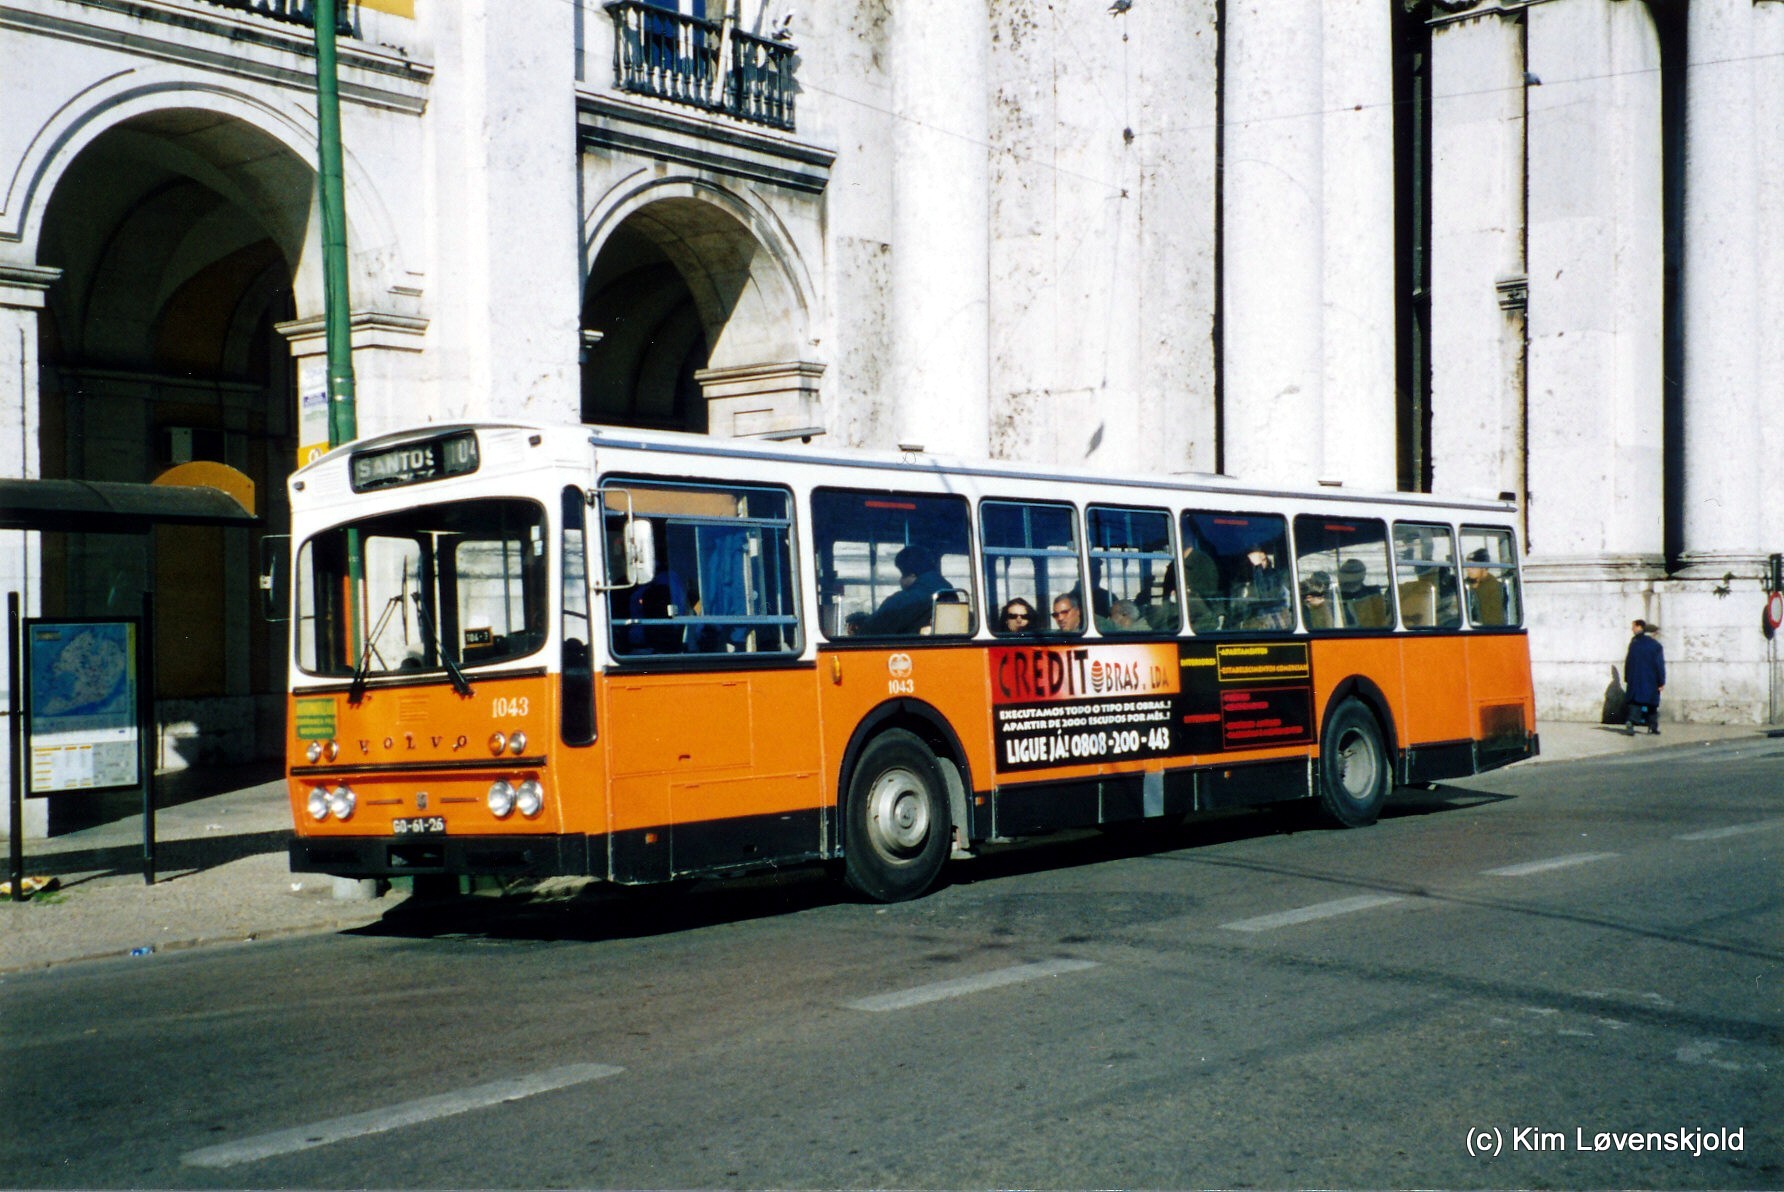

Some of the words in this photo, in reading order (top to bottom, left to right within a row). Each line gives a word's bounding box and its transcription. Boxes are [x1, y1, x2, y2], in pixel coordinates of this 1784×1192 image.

[888, 679, 914, 694] 1043
[492, 697, 529, 718] 1043
[1000, 706, 1065, 720] EXECUTAMOS
[1065, 705, 1092, 716] TODO
[1092, 705, 1101, 714] O
[1101, 703, 1123, 713] TIPO
[1123, 702, 1136, 711] DE
[1002, 720, 1047, 732] APARTIR
[1048, 720, 1061, 729] DE
[1062, 718, 1087, 728] 2000
[1088, 714, 1126, 726] ESCUDOS
[1127, 713, 1146, 722] POR
[359, 734, 468, 752] VOLVO
[1006, 736, 1048, 764] LIGUE
[1049, 728, 1070, 762] JÁ!
